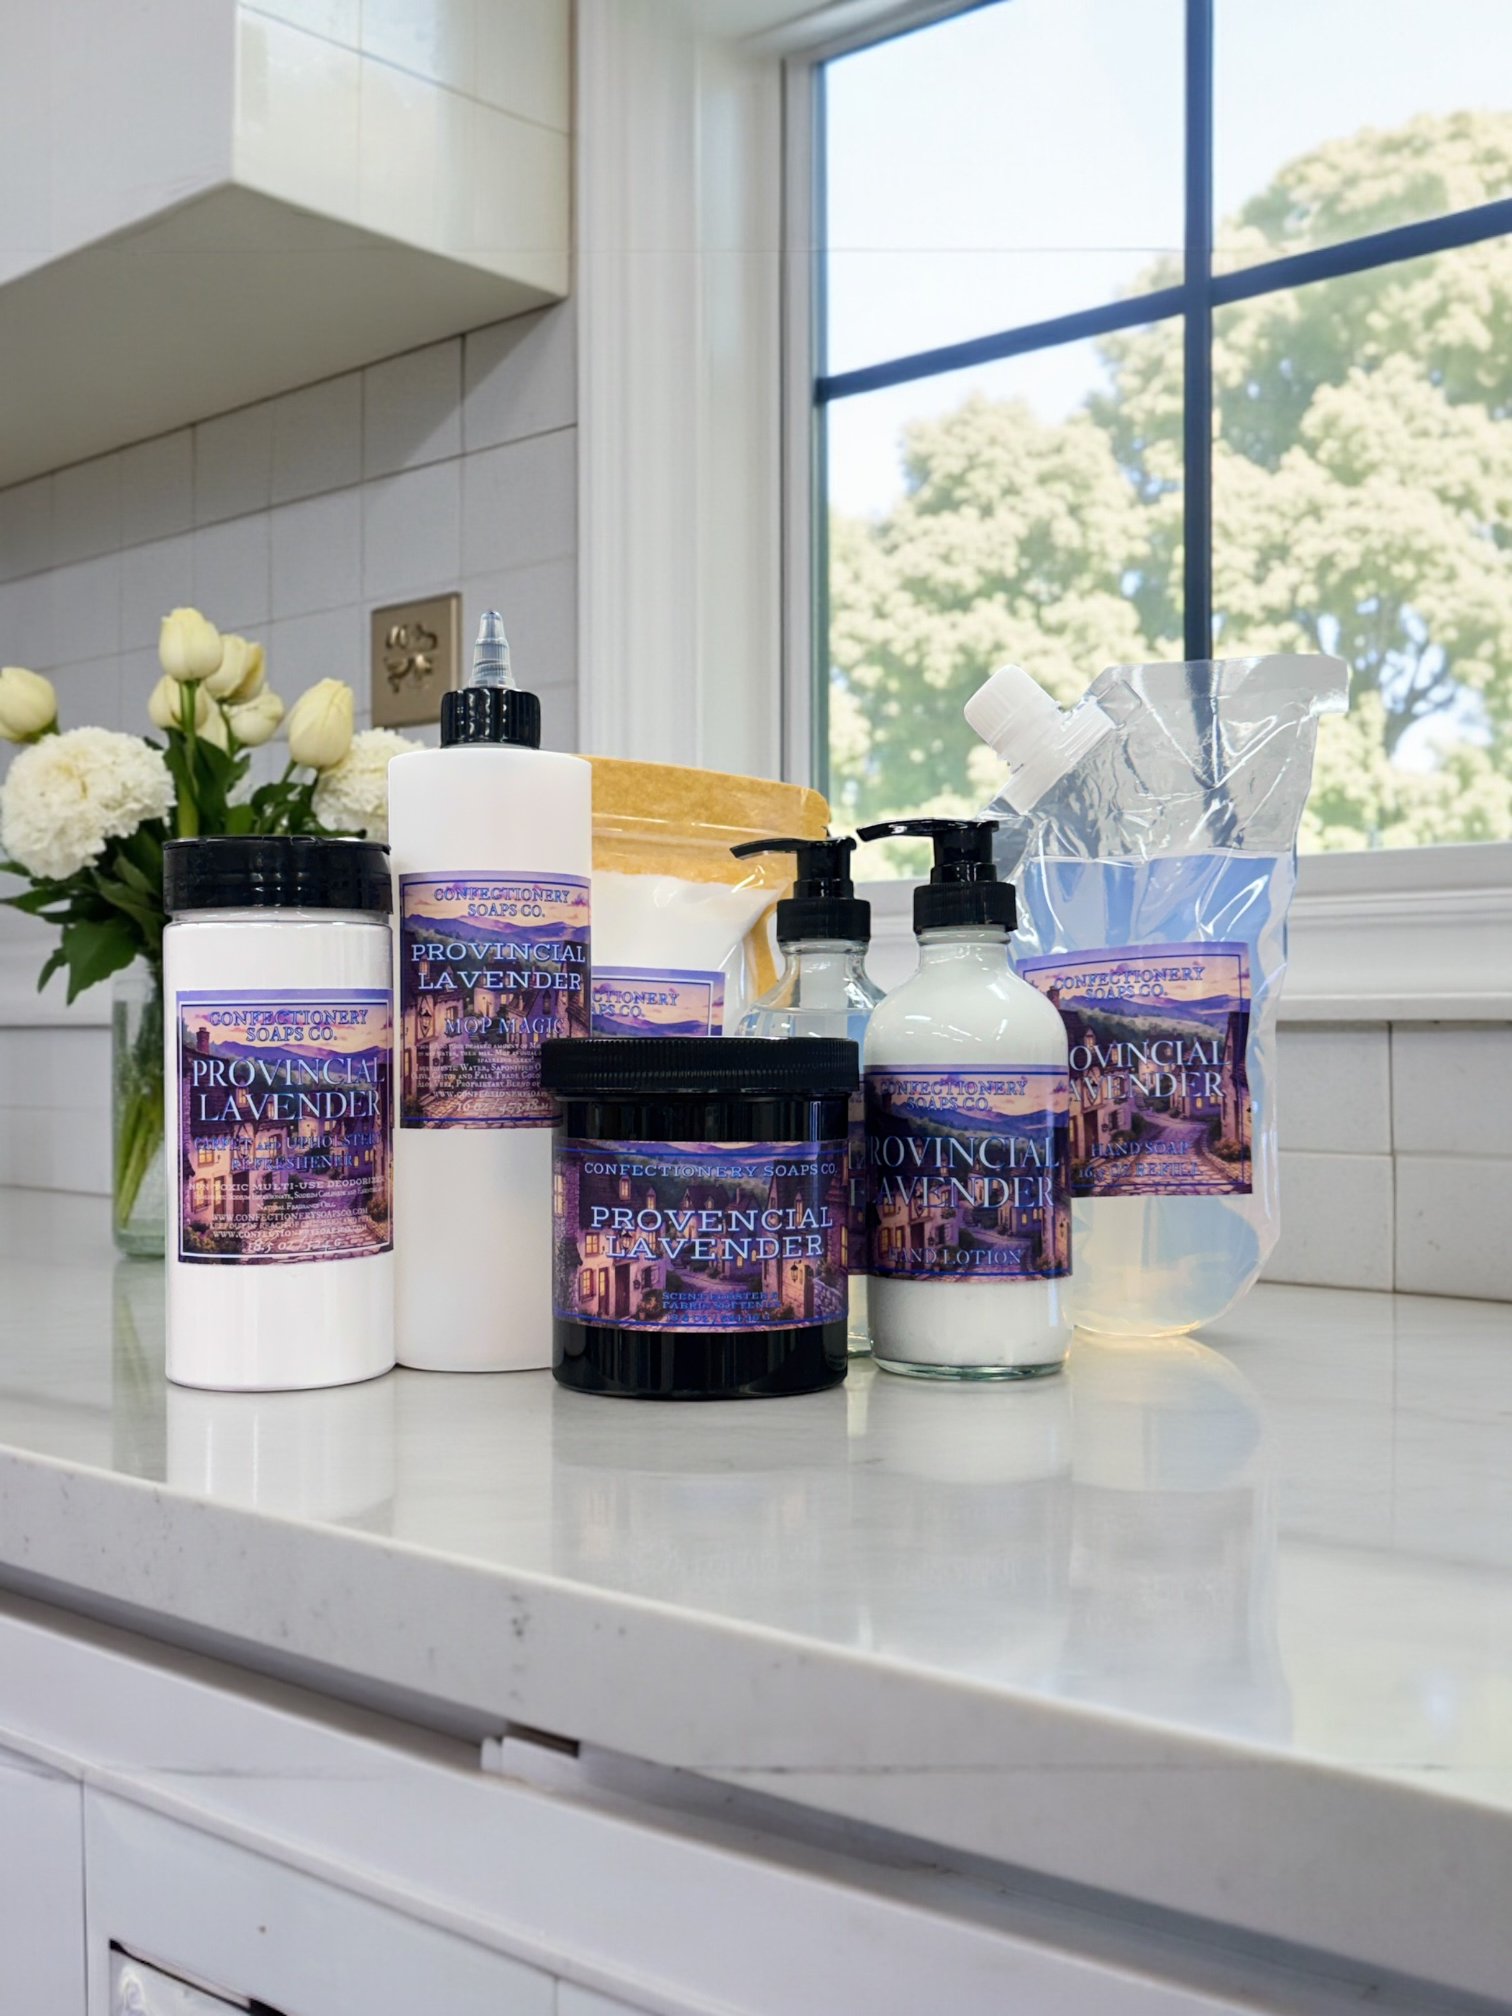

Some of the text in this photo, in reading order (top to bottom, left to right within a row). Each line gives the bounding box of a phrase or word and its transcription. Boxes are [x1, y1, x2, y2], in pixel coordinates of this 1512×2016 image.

[433, 887, 570, 903] CONFECTIONERY
[467, 903, 545, 918] SOAPS CO.
[410, 942, 586, 963] PROVINCIAL
[418, 970, 582, 991] LAVENDER
[1053, 966, 1206, 990] CONFECTIONERY
[591, 990, 680, 1006] CTIONERY
[1085, 983, 1168, 1001] SOAPS CO.
[208, 1009, 368, 1025] CONFECTIONERY
[591, 1004, 646, 1018] APS CO.
[444, 1017, 564, 1035] MOP MAGIC
[246, 1027, 338, 1042] SOAPS CO.
[1069, 1039, 1230, 1071] OVINCIAL
[192, 1056, 385, 1087] PROVINCIAL
[460, 1063, 490, 1072] WATER,
[490, 1063, 534, 1071] SAPONIFIED
[456, 1080, 504, 1088] PROPRIETARY
[506, 1080, 530, 1088] BLEND
[474, 1072, 492, 1080] FAIR
[494, 1072, 520, 1080] TRADE
[880, 1080, 1028, 1096] CONFECTIONERY
[1069, 1071, 1226, 1102] AVENDER
[199, 1089, 381, 1121] LAVENDER
[456, 1100, 470, 1112] 16
[907, 1097, 992, 1111] SOAPS CO.
[867, 1136, 1059, 1169] ROVINCIAL
[1090, 1140, 1190, 1158] HAND SOAP
[230, 1155, 354, 1170] REFRESHENER
[584, 1163, 838, 1178] CONFECTIONERY SOAPS CO.
[252, 1180, 324, 1191] MULTI-USE
[876, 1175, 1054, 1209] AVENDER
[591, 1206, 833, 1232] PROVENCIAL
[605, 1234, 824, 1260] LAVENDER
[888, 1249, 1022, 1266] HAND LOTION
